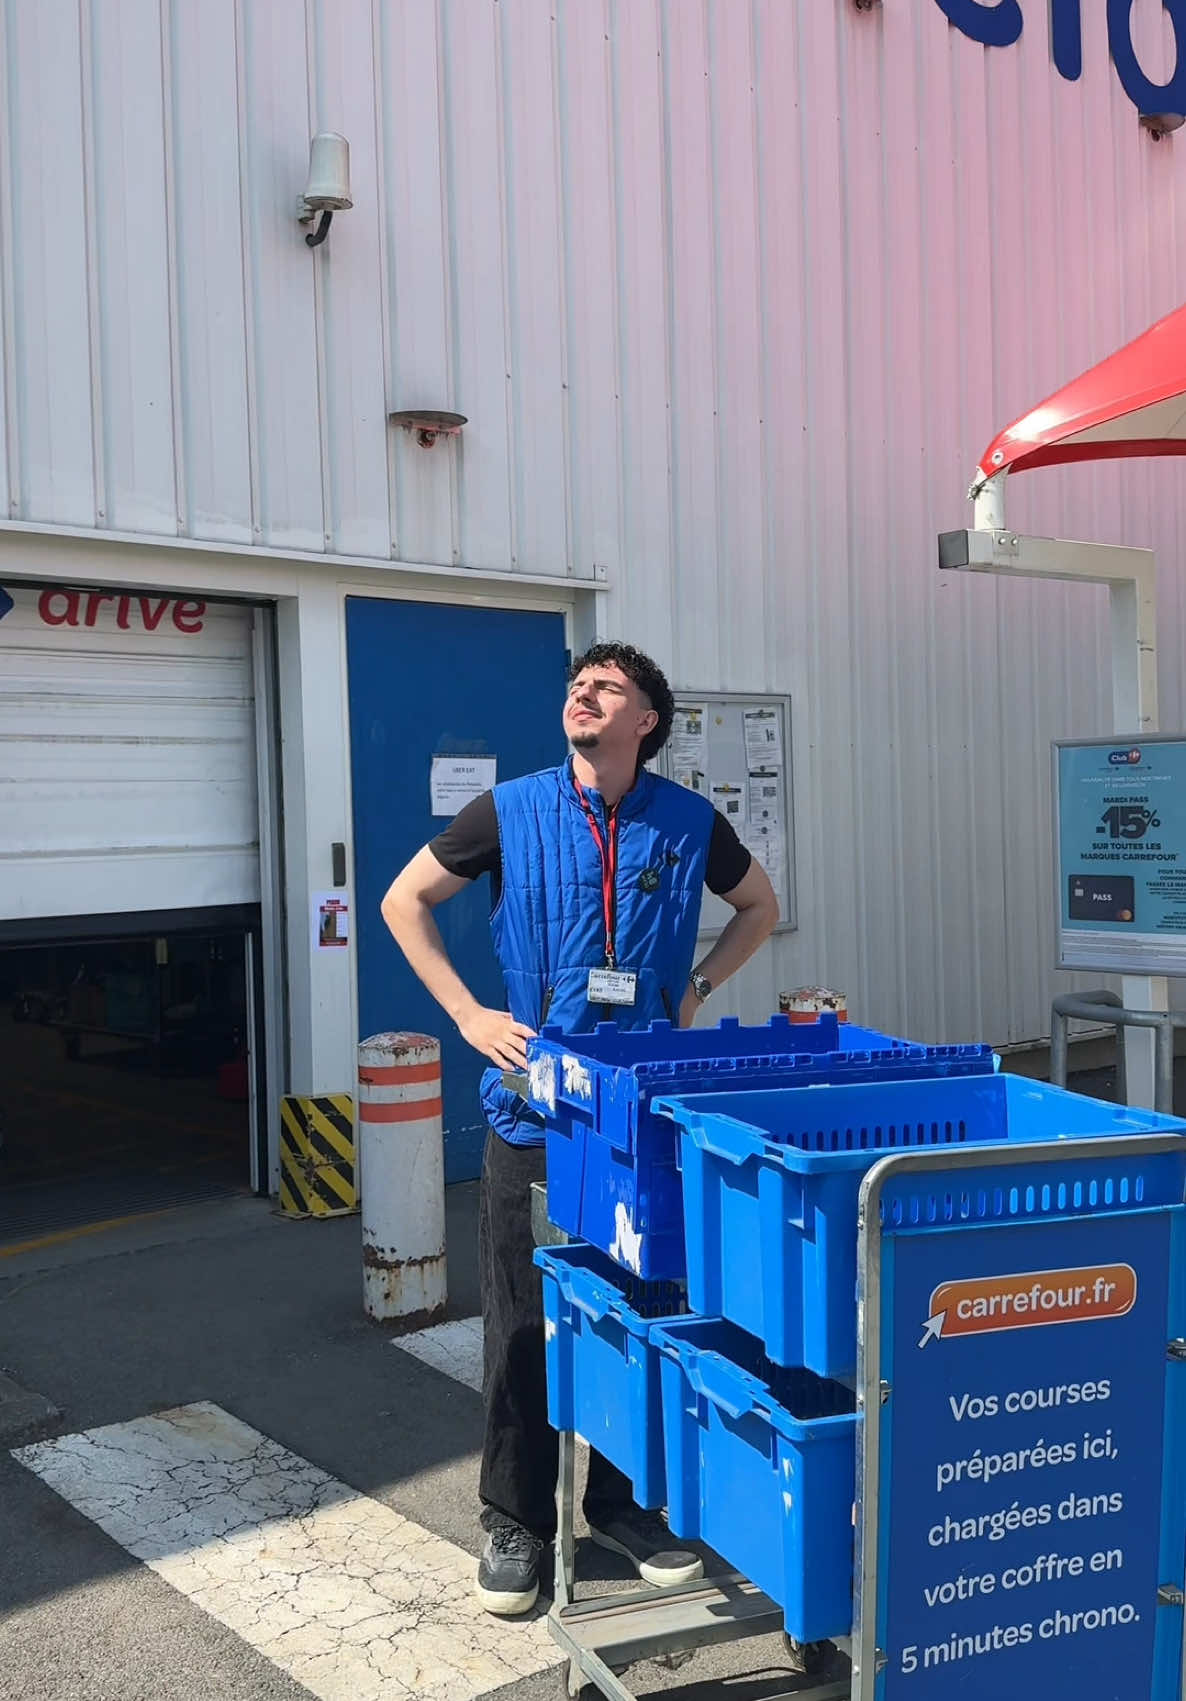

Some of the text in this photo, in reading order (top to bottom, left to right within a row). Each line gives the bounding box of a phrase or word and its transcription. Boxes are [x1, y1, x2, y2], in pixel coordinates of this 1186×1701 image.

[1096, 805, 1161, 839] -15%
[1146, 842, 1162, 850] LES
[1092, 893, 1112, 901] PASS
[957, 1277, 1116, 1320] carrefour.fr
[949, 1379, 1111, 1422] Vos courses
[937, 1430, 1119, 1491] préparées ici,
[928, 1490, 1123, 1547] chargées dans
[924, 1546, 1123, 1607] votre coffre en
[901, 1601, 1141, 1673] 5 minutes chrono.
